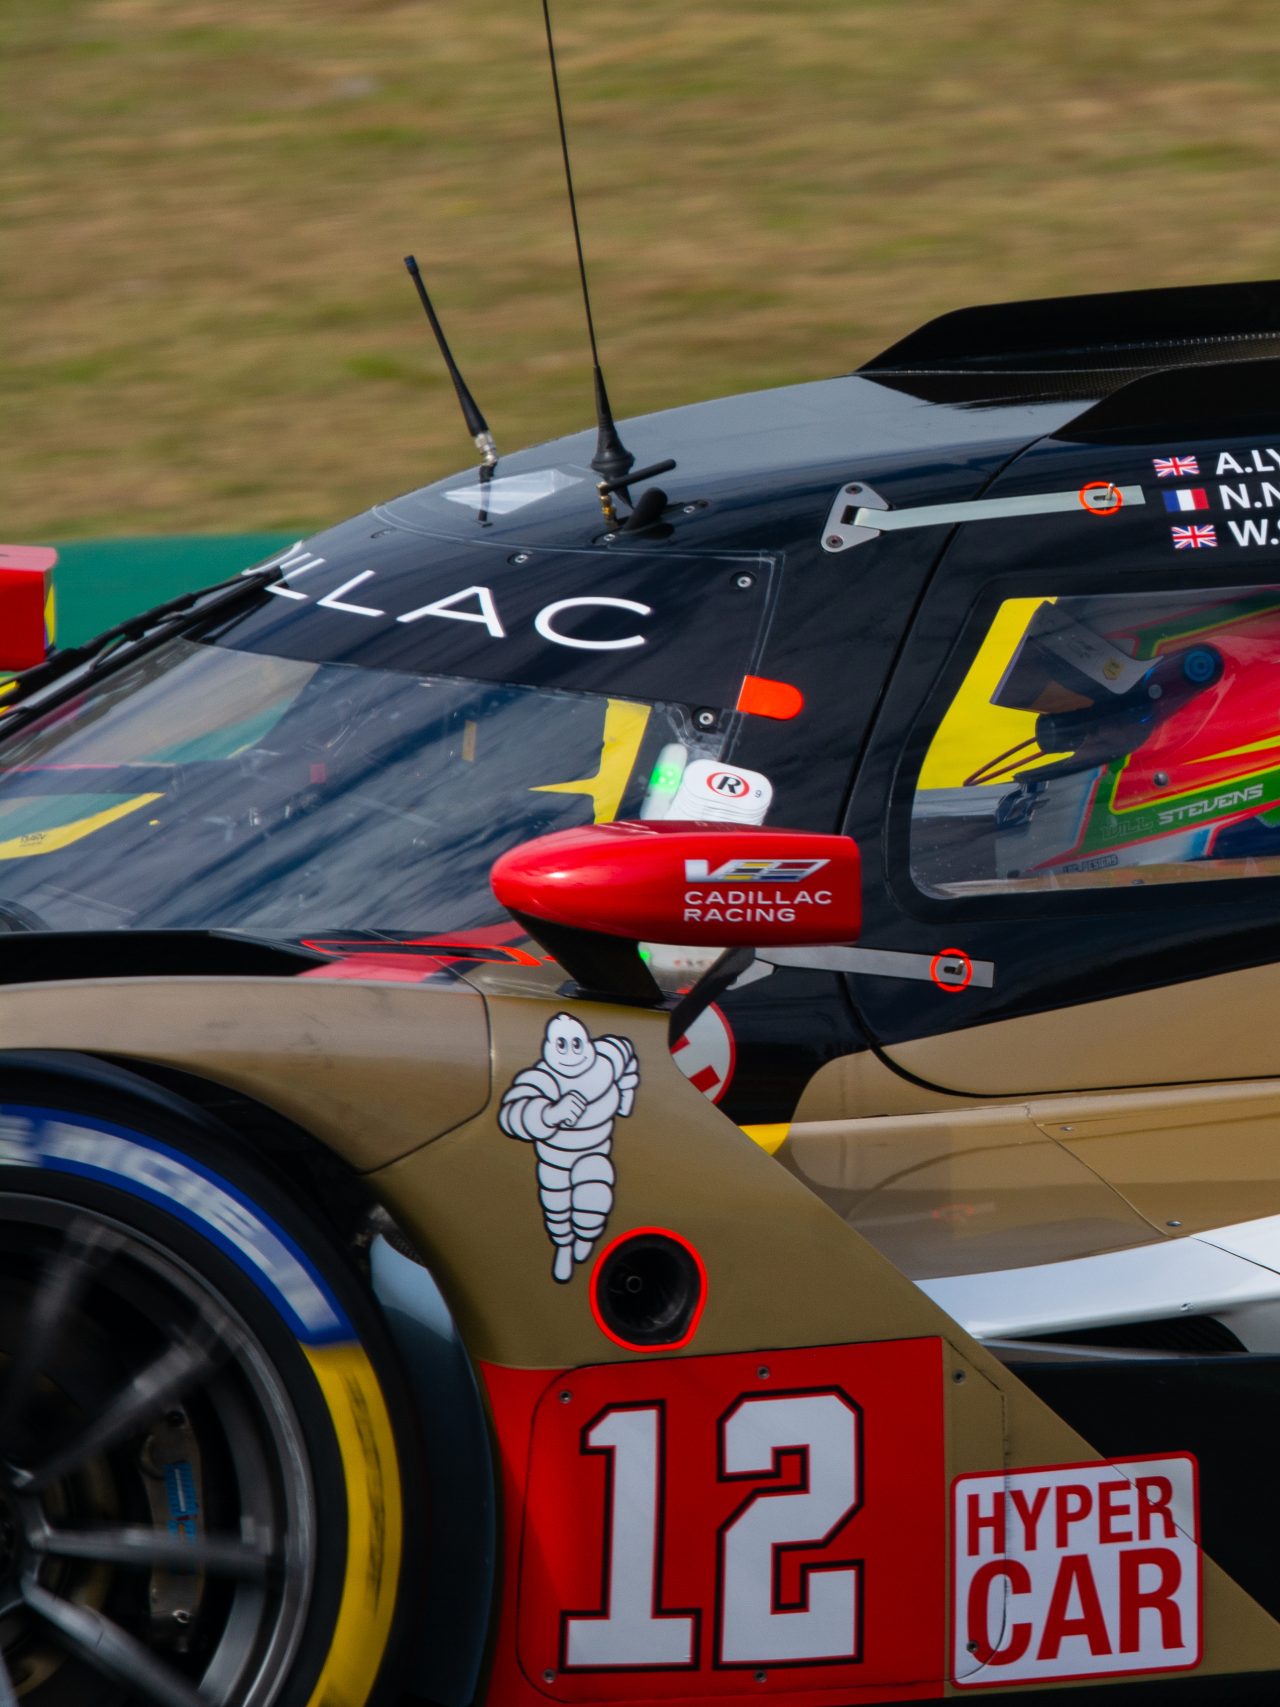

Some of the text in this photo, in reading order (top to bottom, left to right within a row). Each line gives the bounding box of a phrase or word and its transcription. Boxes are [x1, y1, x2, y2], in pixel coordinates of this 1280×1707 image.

[1158, 784, 1264, 825] STEVENS
[683, 908, 797, 922] RACING
[684, 890, 833, 905] CADILLAC
[558, 1384, 865, 1674] 12
[965, 1475, 1178, 1557] HYPER
[965, 1547, 1187, 1667] CAR
